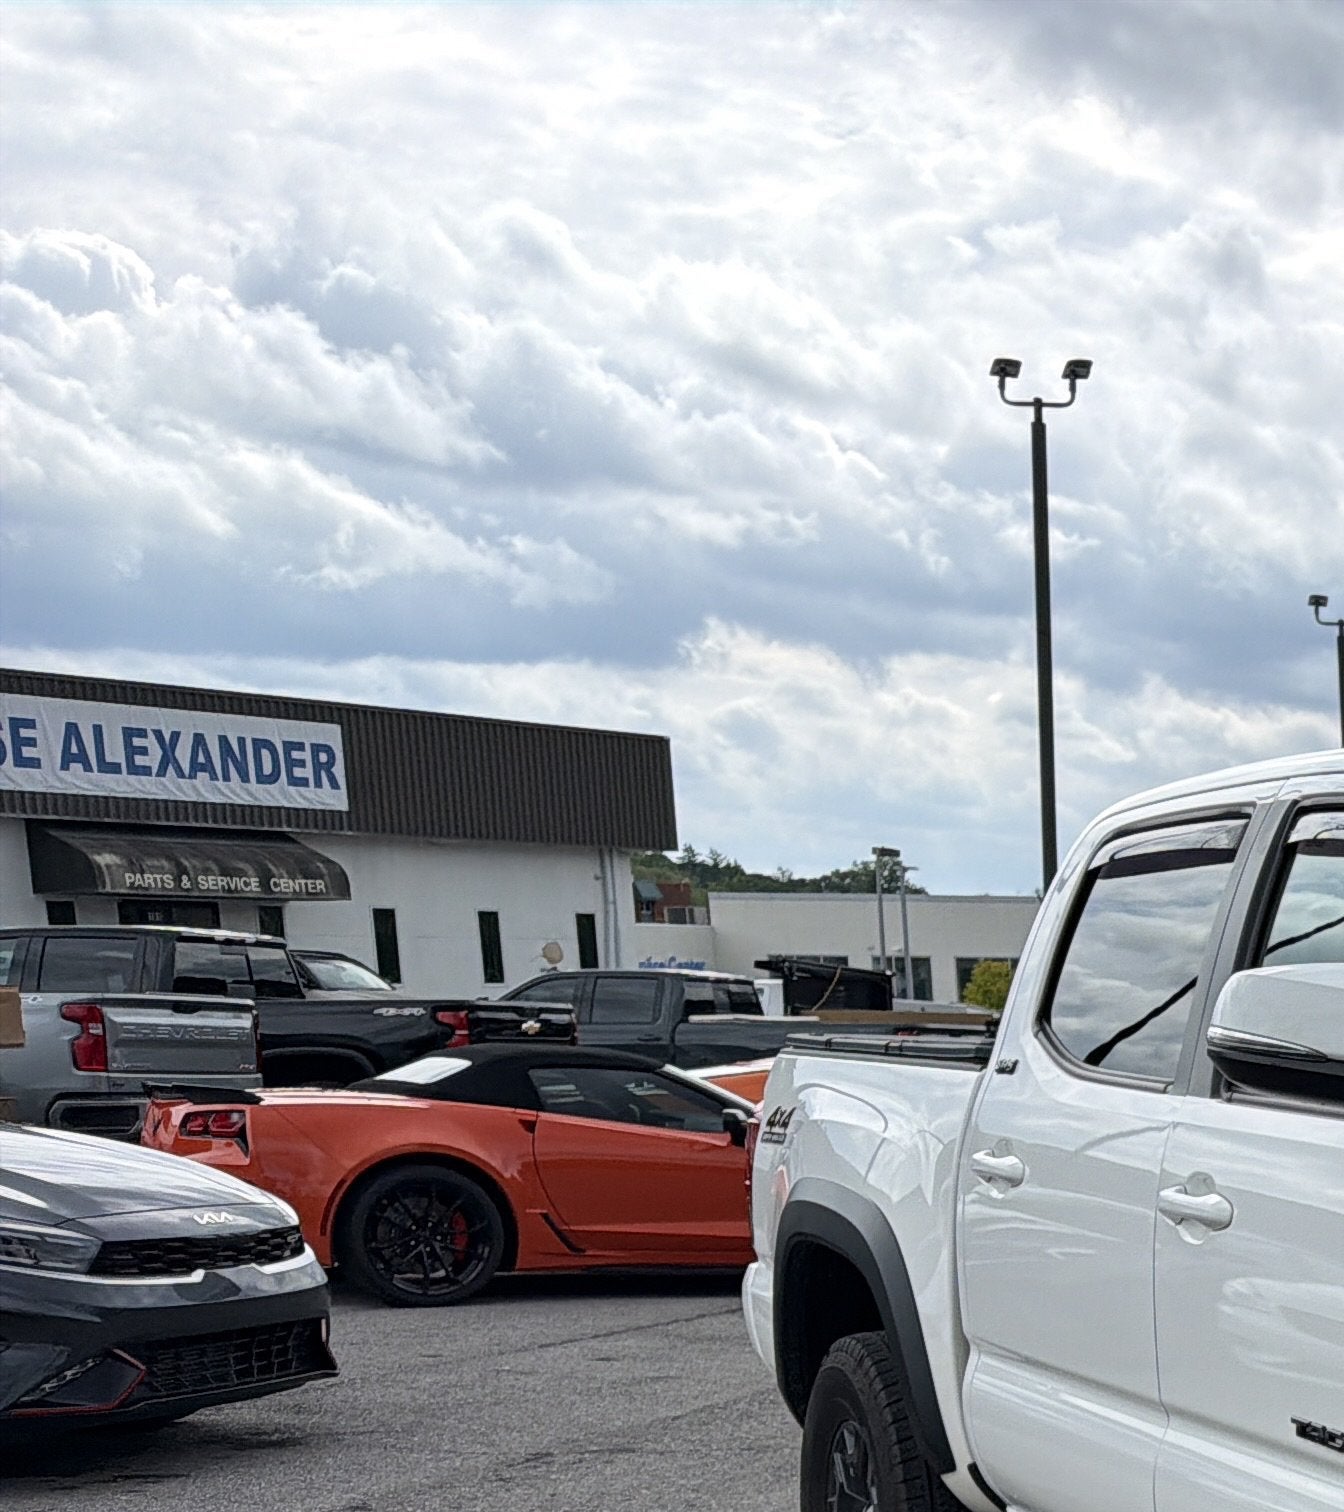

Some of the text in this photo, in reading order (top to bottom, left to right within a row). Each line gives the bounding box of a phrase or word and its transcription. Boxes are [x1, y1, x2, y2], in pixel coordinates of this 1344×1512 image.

[60, 721, 341, 790] ALEXANDER
[125, 872, 327, 894] PARTS & SERVICE CENTER
